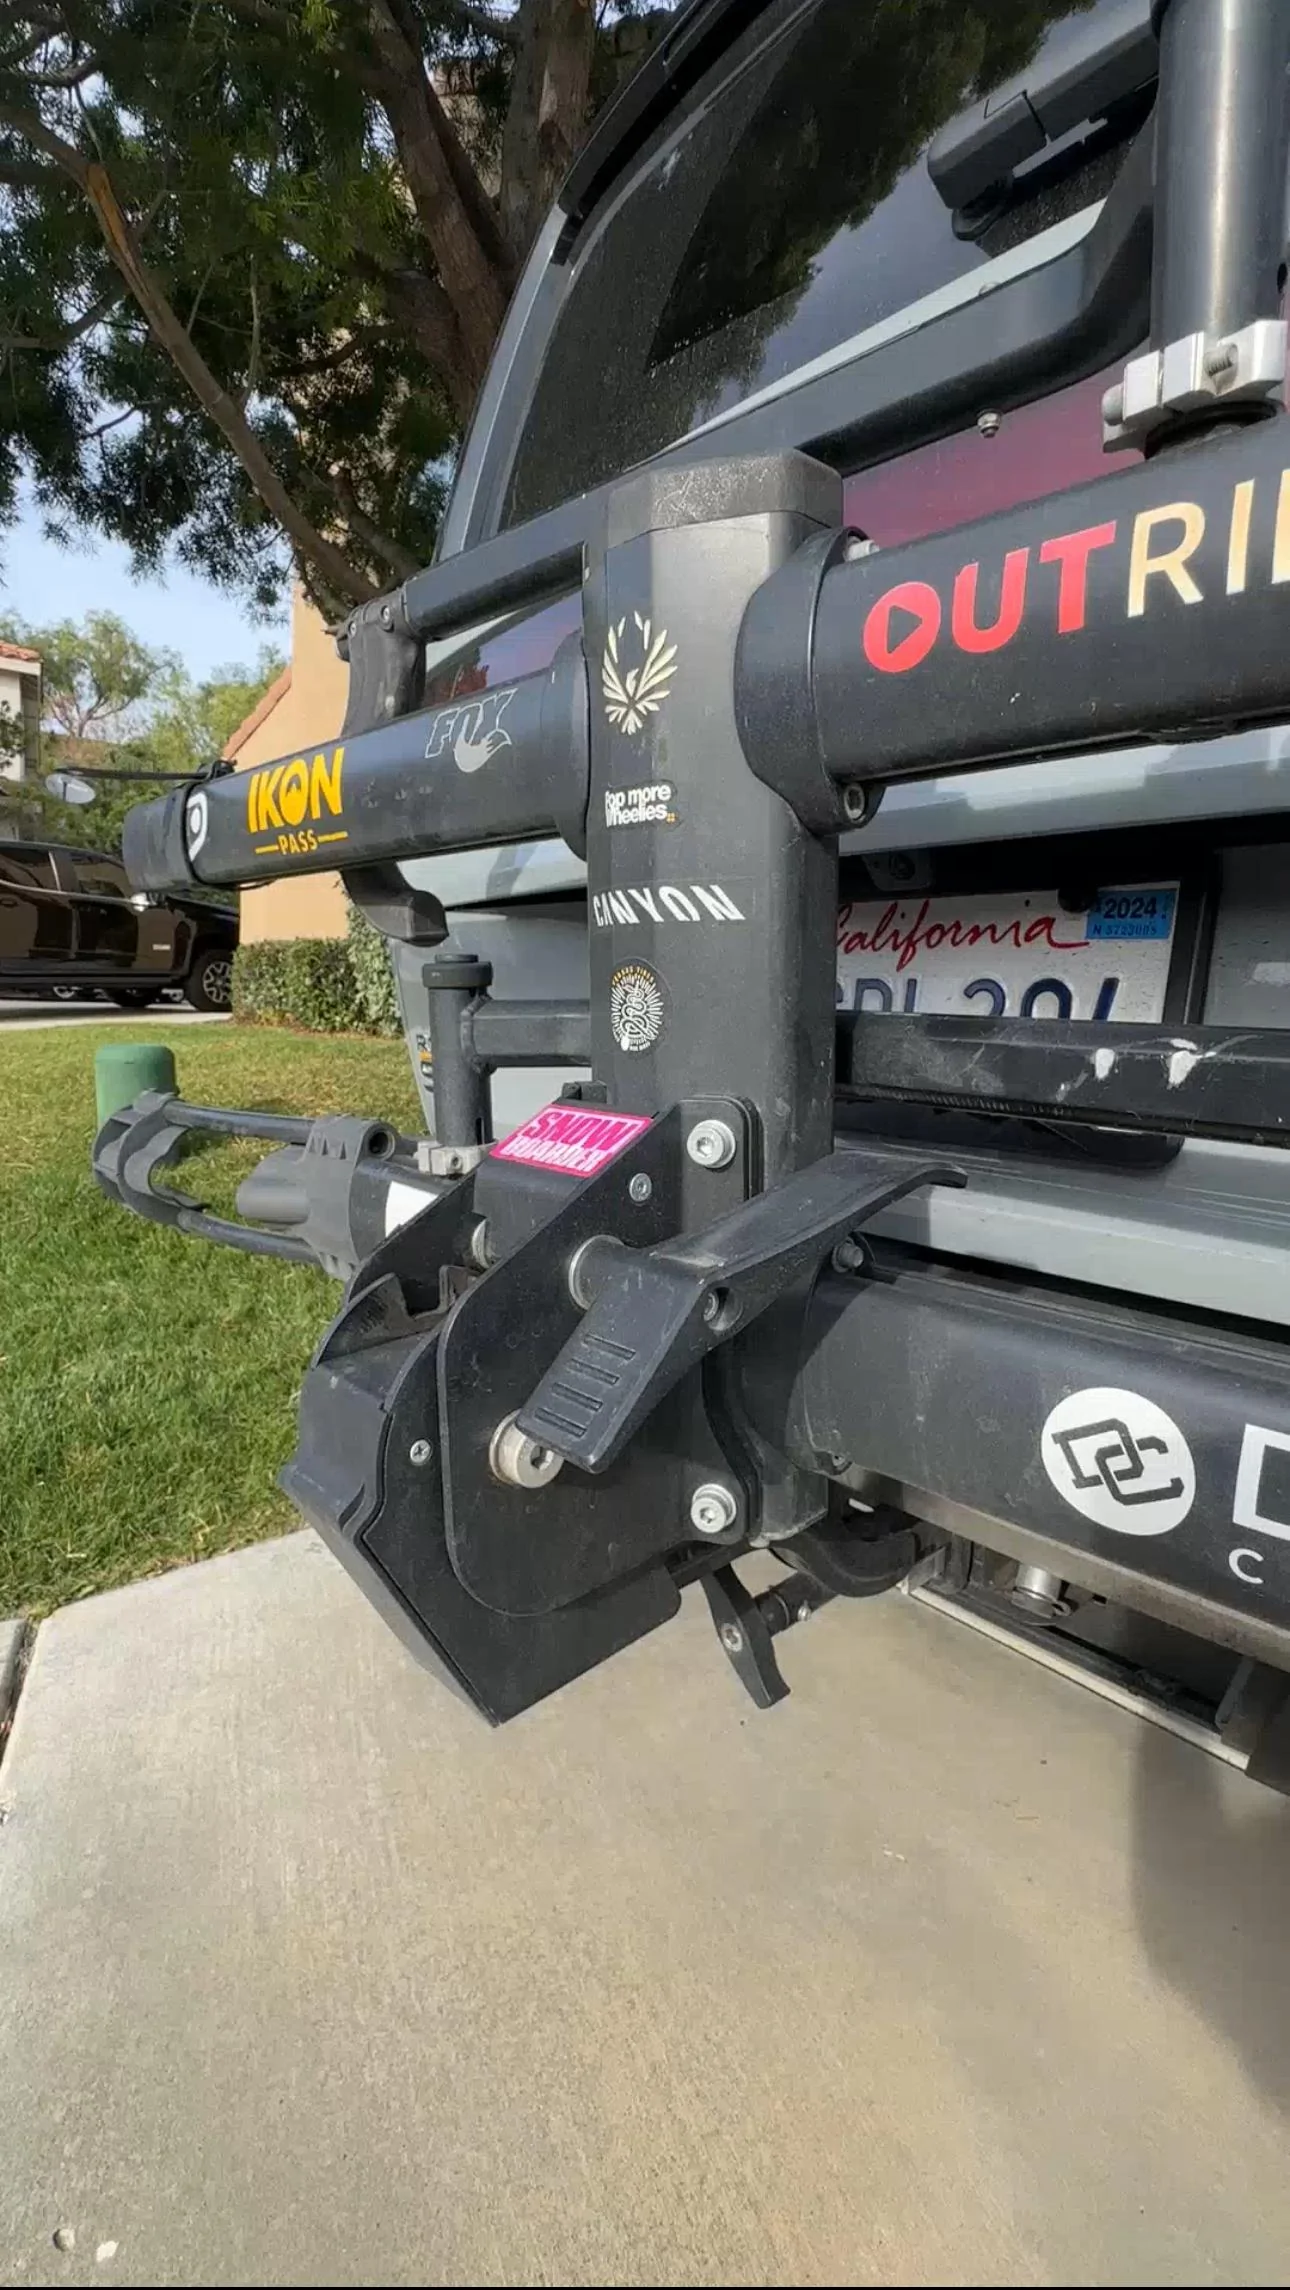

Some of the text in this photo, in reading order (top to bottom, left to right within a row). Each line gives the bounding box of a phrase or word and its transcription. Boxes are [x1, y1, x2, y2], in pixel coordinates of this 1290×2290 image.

[425, 688, 518, 773] FOX
[248, 747, 345, 834] IKON
[628, 784, 672, 806] more
[278, 829, 319, 855] PASS
[593, 884, 747, 927] CANYON
[1103, 896, 1157, 919] 2024
[521, 1111, 640, 1151] SNOW
